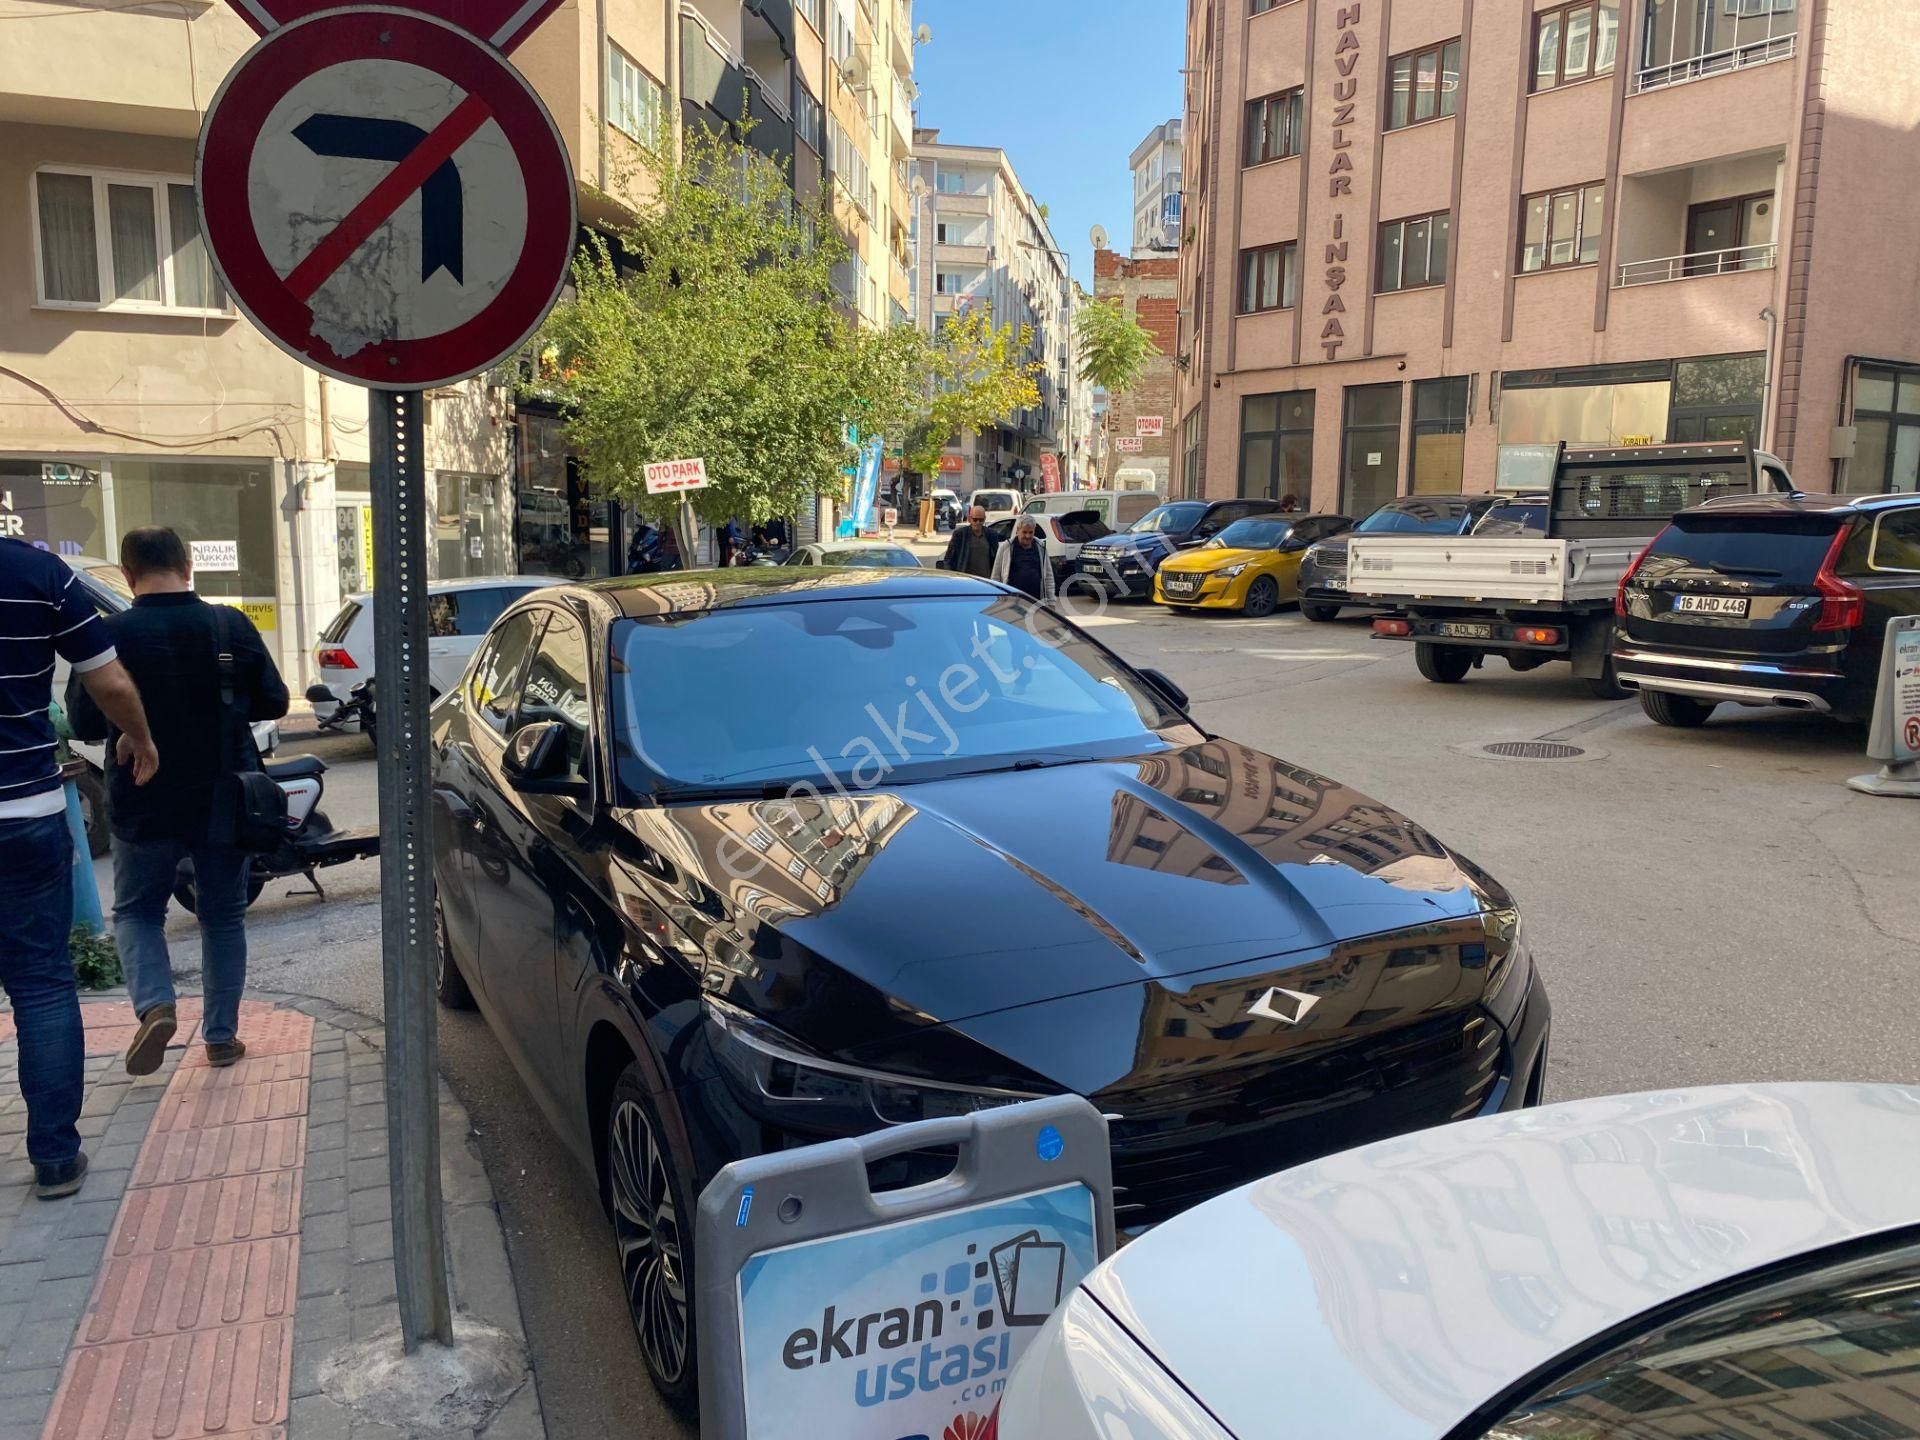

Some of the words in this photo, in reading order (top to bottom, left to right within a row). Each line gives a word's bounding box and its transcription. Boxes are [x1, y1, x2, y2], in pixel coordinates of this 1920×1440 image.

[1329, 3, 1361, 198] HAVUZLAR
[1321, 213, 1348, 361] İNŞAAT
[1137, 418, 1161, 430] OTOPARK
[648, 465, 671, 480] OTO
[672, 461, 701, 478] PARK
[1681, 597, 1693, 609] 16
[1696, 598, 1719, 611] AHD
[1722, 601, 1745, 613] 448
[1454, 624, 1473, 636] ADL
[1474, 625, 1490, 637] 375
[782, 1300, 943, 1370] ekran
